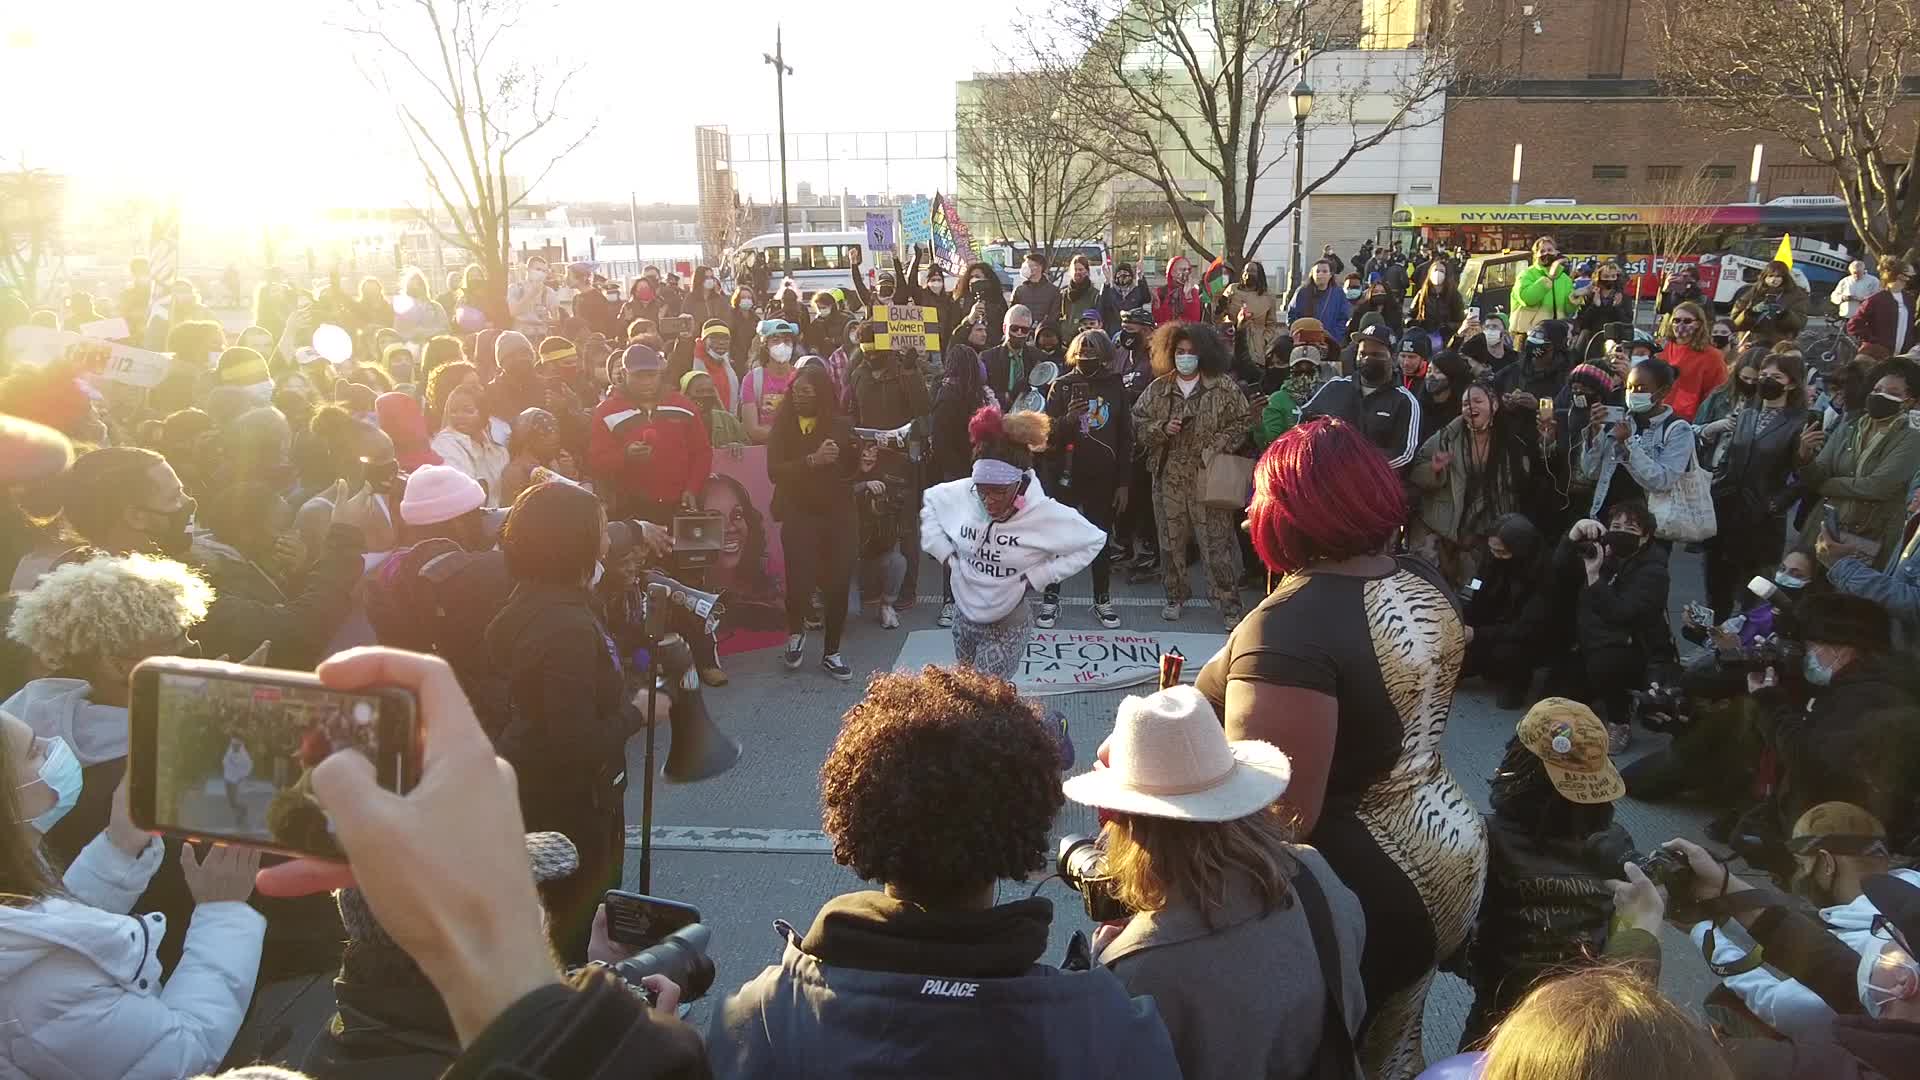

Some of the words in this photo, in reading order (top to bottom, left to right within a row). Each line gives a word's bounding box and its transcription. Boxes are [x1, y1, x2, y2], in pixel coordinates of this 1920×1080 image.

[1461, 212, 1486, 221] NY
[1489, 212, 1639, 221] WATERWAY.COM
[1652, 256, 1696, 274] Ferr
[890, 307, 924, 321] BLACK
[891, 335, 925, 346] MATTER
[960, 525, 1020, 547] UNCK
[1069, 634, 1106, 643] HER
[921, 979, 980, 997] PALACE
